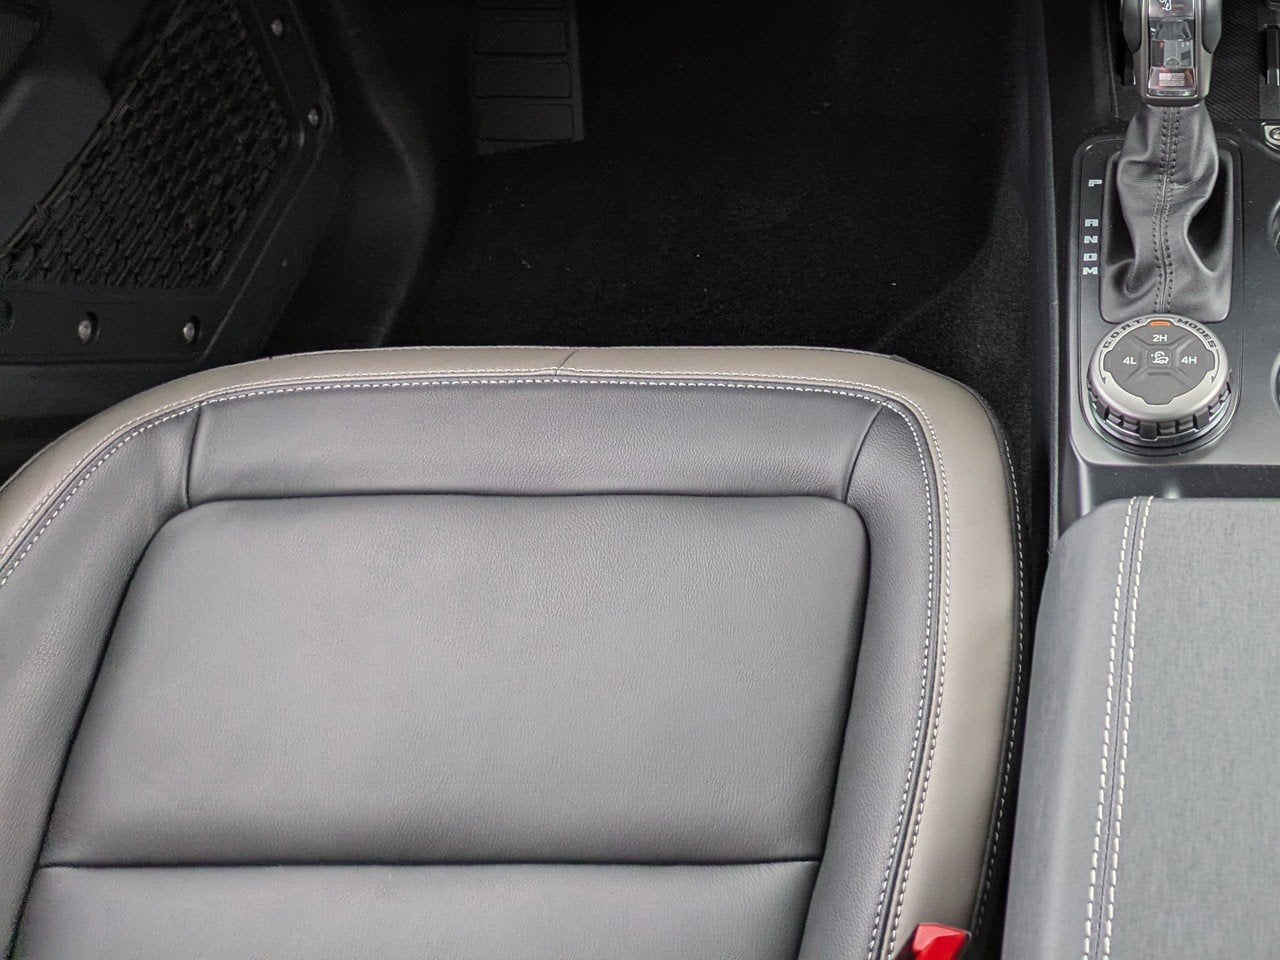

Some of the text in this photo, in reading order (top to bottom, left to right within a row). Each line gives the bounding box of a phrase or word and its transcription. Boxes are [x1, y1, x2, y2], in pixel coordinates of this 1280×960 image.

[1088, 179, 1103, 187] P
[1085, 218, 1099, 227] R
[1084, 235, 1099, 244] N
[1083, 252, 1098, 261] D
[1082, 267, 1098, 275] M
[1152, 334, 1168, 342] 2H
[1177, 318, 1217, 349] MODES
[1123, 357, 1137, 365] 4L
[1181, 356, 1197, 365] 4H
